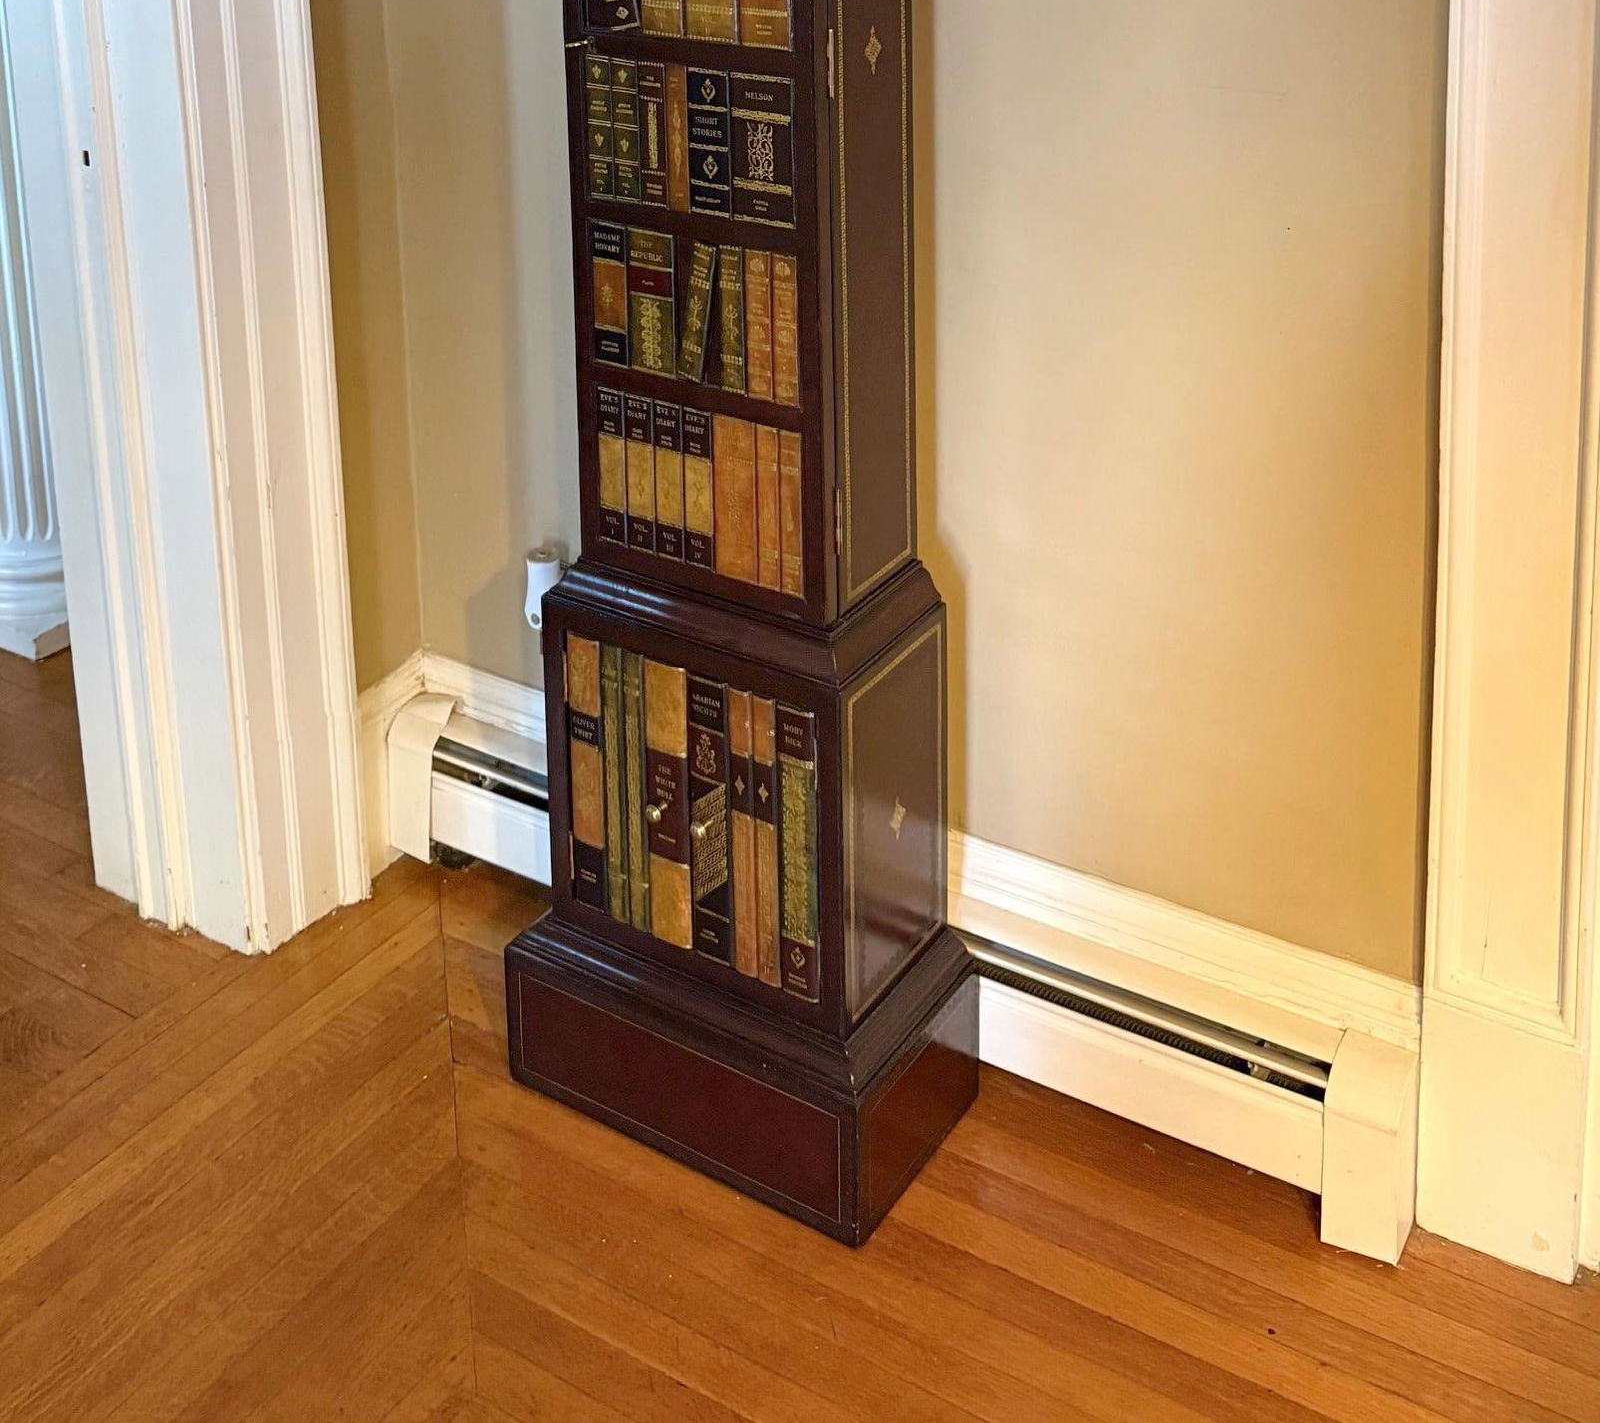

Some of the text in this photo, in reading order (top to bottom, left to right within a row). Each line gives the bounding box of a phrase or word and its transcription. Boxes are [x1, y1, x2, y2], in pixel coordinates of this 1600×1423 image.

[745, 91, 773, 101] NELSON
[695, 117, 718, 125] SHORT
[692, 129, 722, 138] STORIES
[594, 232, 620, 242] MADAME
[595, 243, 620, 253] BOVARY
[631, 251, 663, 263] REPUBLIC
[601, 394, 618, 403] EVE'S
[600, 404, 619, 415] DIARY
[627, 410, 646, 420] DIARY
[656, 417, 676, 428] DIARY
[684, 424, 704, 435] DIARY
[633, 522, 648, 532] VOL.
[663, 531, 676, 541] VOL.
[691, 538, 704, 548] VOL.
[692, 694, 720, 708] ARABIAN
[573, 716, 595, 730] OLIVER
[658, 764, 672, 776] THE
